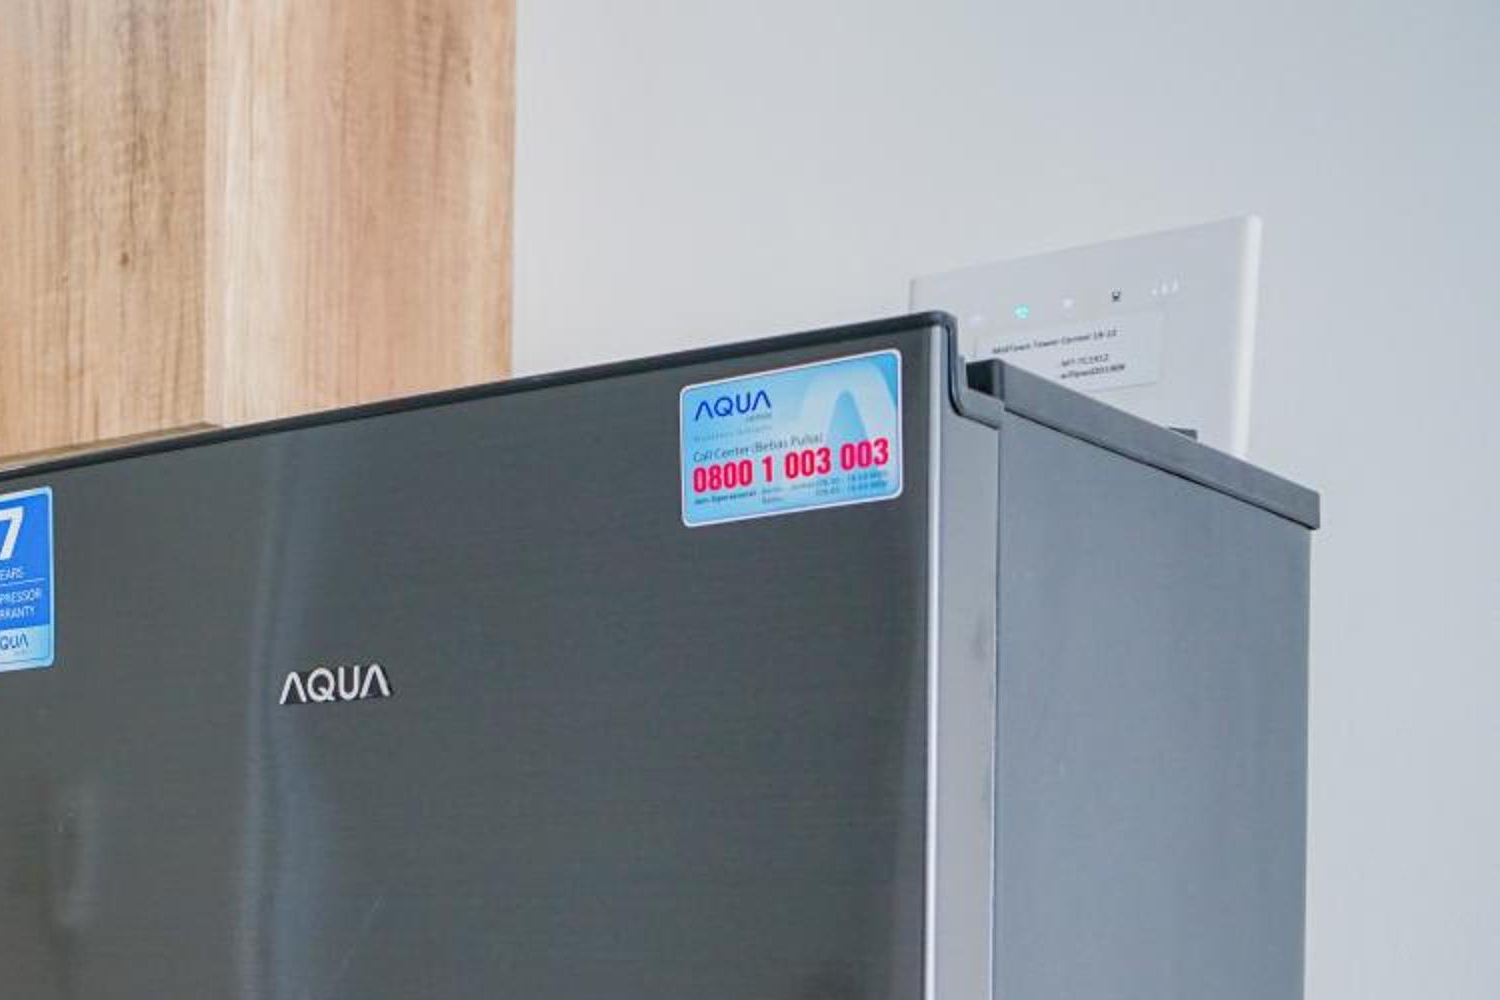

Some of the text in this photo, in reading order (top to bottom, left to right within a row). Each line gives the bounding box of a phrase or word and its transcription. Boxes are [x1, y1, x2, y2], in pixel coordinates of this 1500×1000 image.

[695, 390, 771, 421] AQUA
[693, 450, 713, 463] Call
[714, 446, 750, 461] Center
[693, 459, 754, 493] 0800
[762, 456, 774, 483] 1
[784, 446, 831, 479] 003
[840, 437, 889, 471] 003
[279, 663, 391, 705] AQUA
